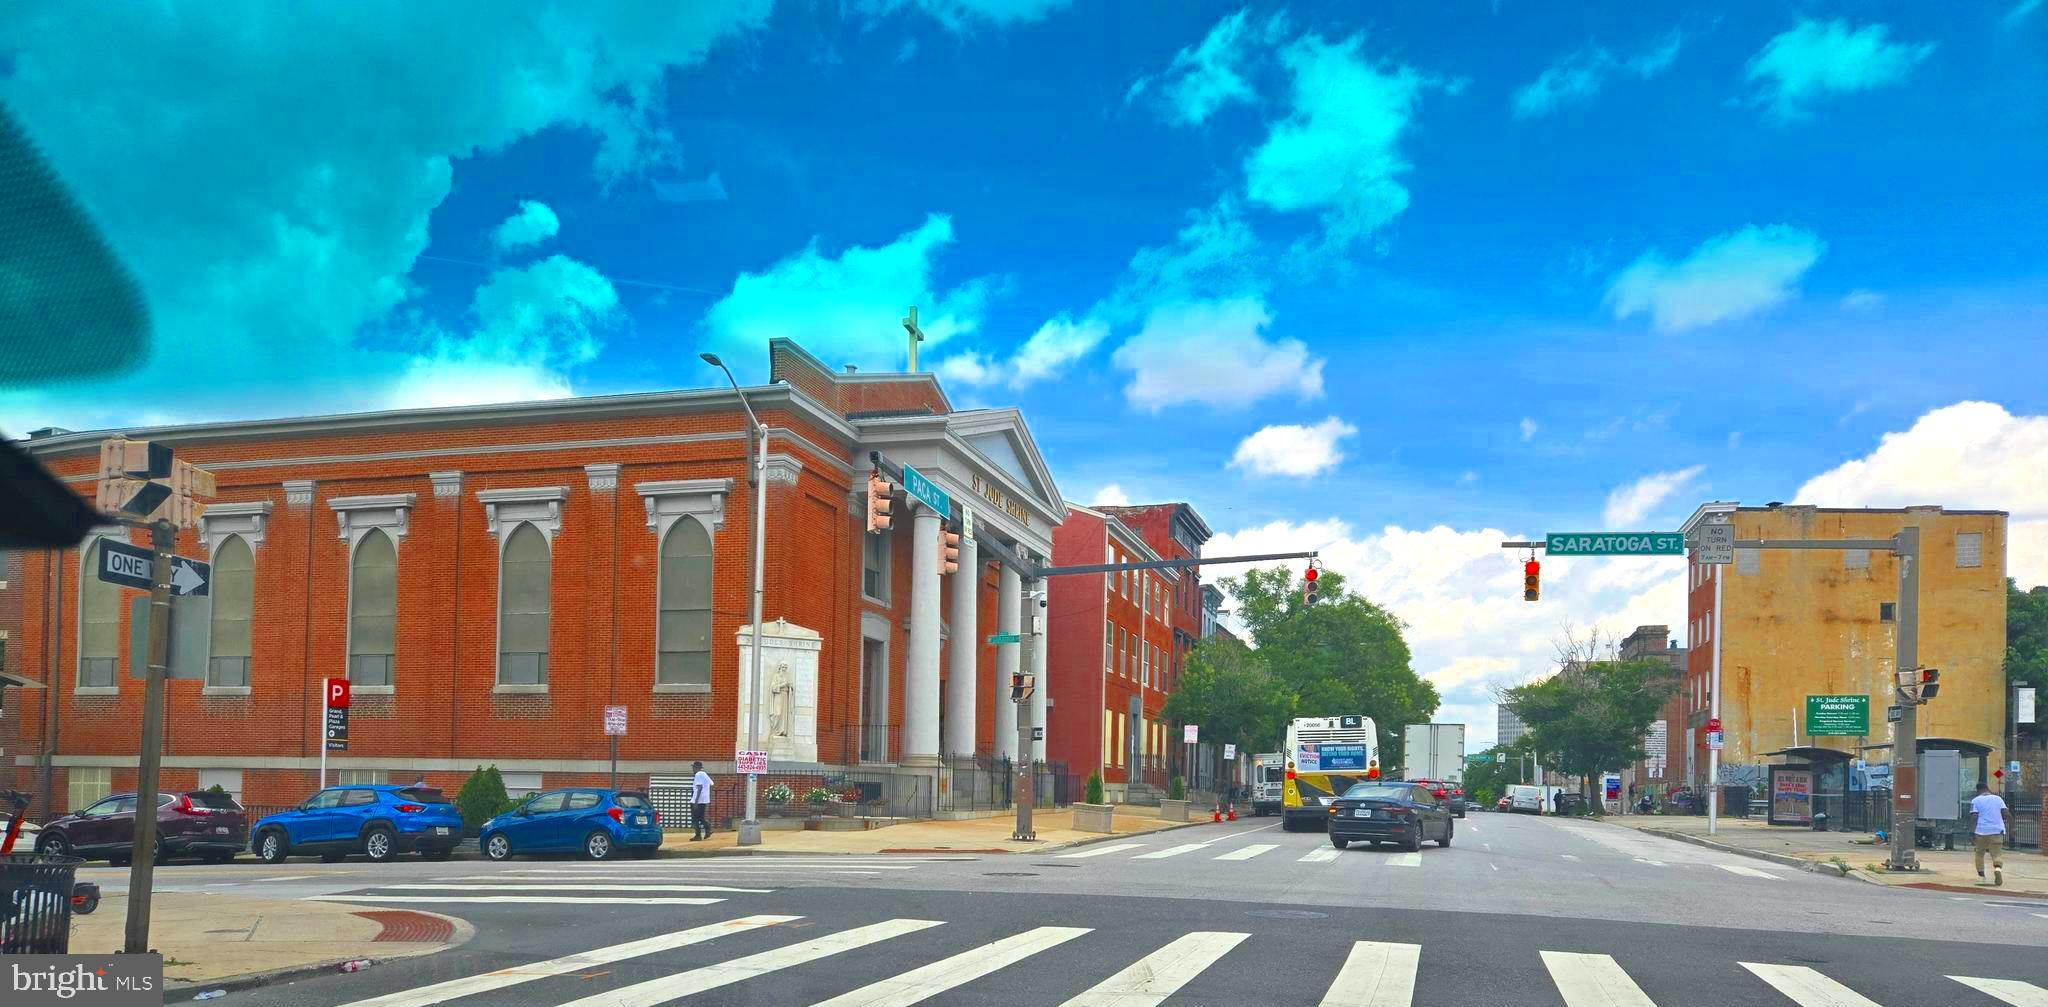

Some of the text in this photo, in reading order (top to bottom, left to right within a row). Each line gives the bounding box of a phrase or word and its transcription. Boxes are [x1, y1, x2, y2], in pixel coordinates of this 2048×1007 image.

[912, 475, 931, 503] PACA
[972, 473, 1031, 527] ST JUDE SHRINE
[1552, 537, 1679, 552] SARATOGA ST.
[111, 554, 144, 576] ONE
[332, 684, 344, 701] P
[1825, 697, 1839, 705] Jude
[1345, 717, 1357, 725] BL
